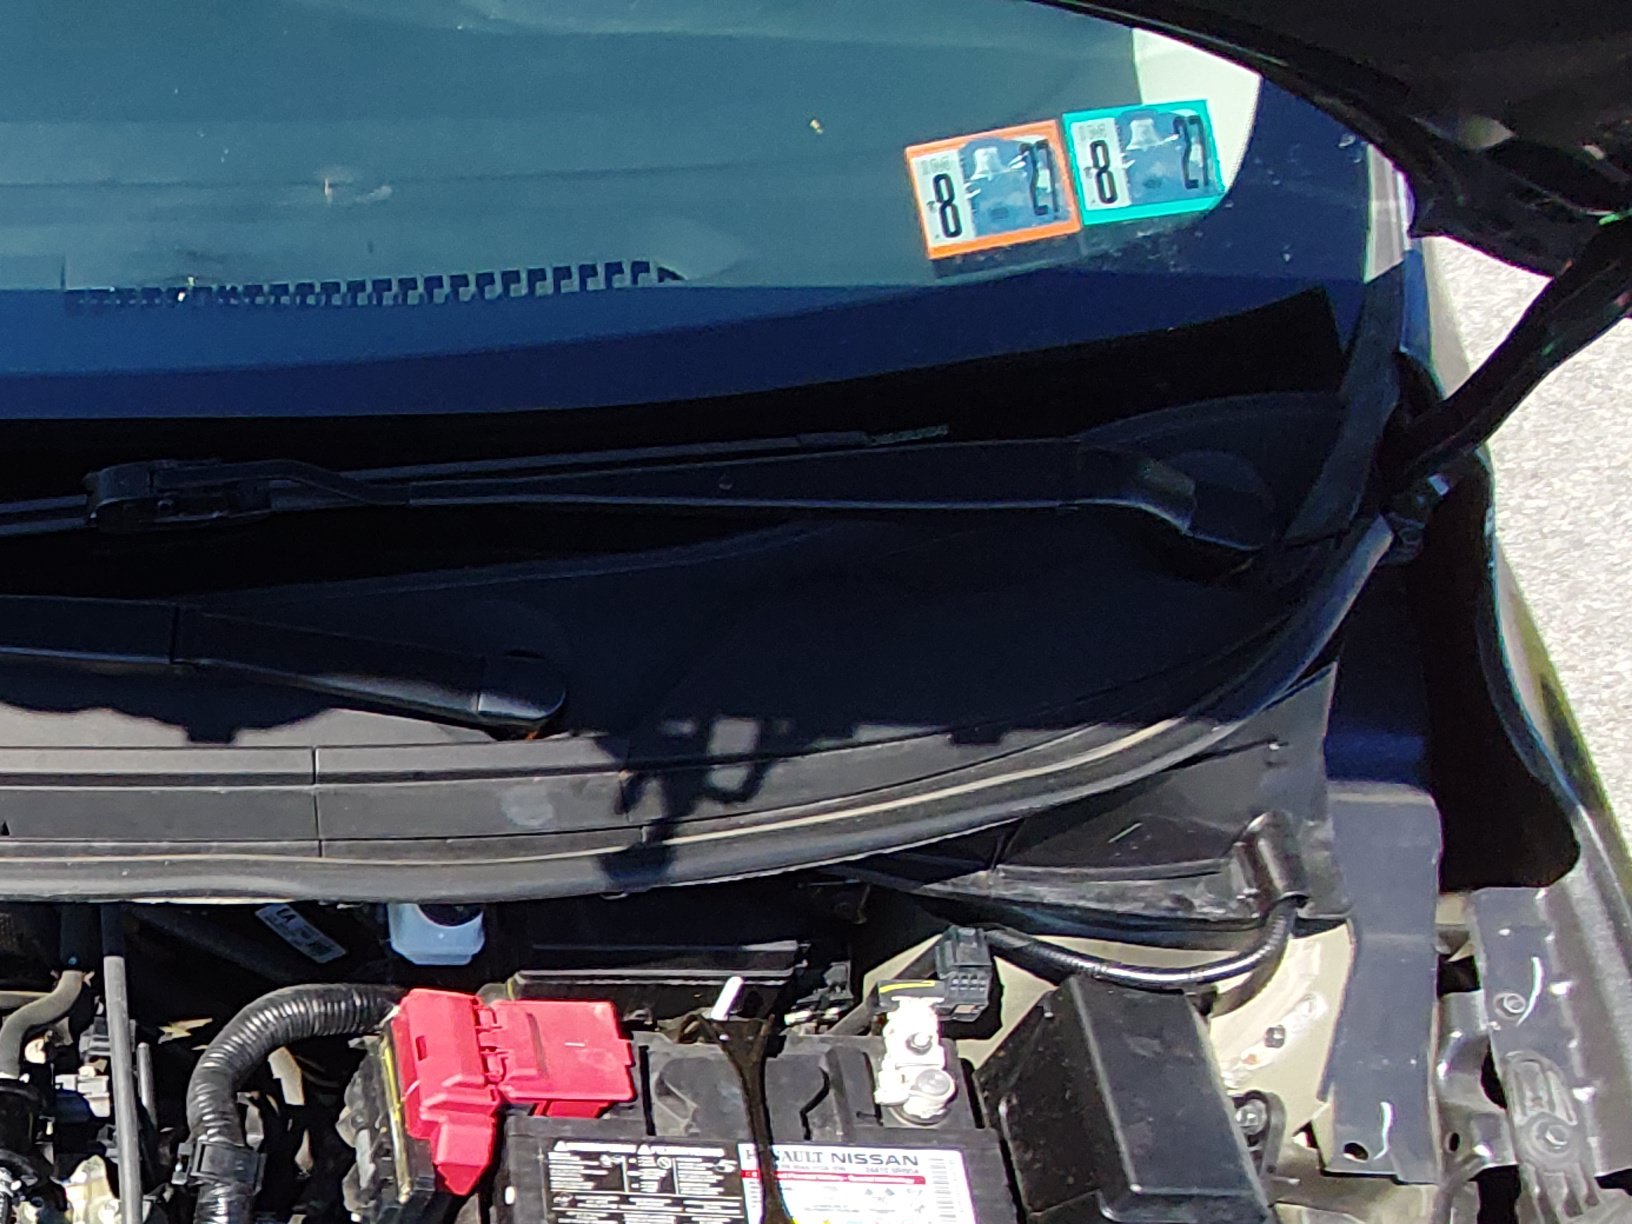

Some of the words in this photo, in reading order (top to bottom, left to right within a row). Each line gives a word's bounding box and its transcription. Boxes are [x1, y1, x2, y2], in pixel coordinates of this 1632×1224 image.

[1089, 140, 1118, 204] 8
[932, 173, 962, 238] 8
[831, 1152, 918, 1166] NISSAN
